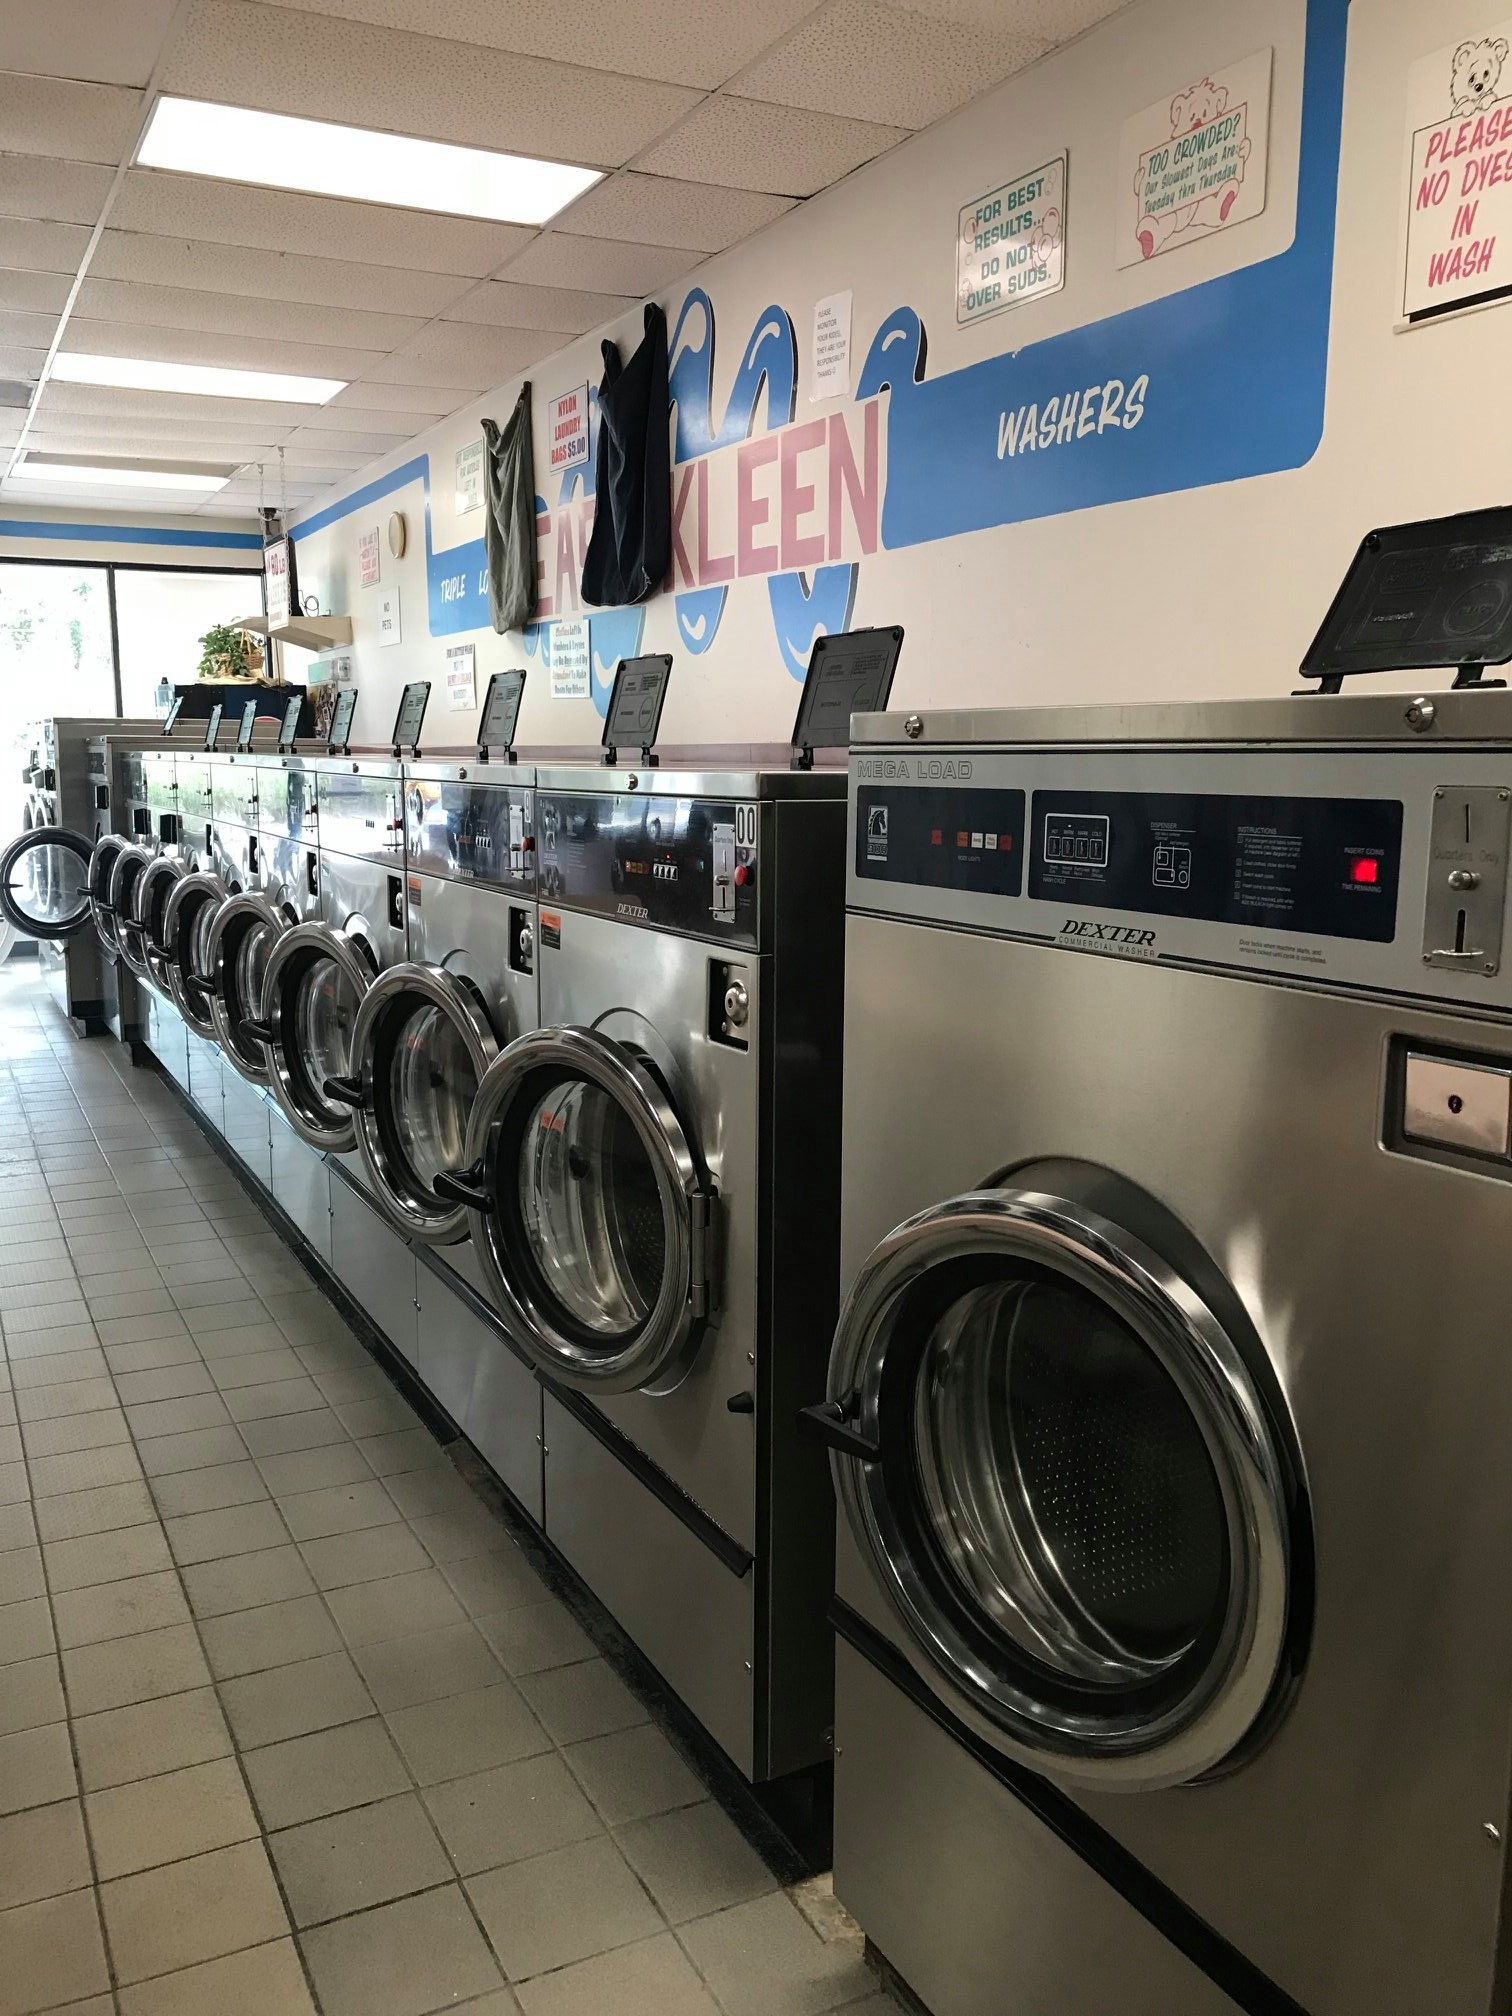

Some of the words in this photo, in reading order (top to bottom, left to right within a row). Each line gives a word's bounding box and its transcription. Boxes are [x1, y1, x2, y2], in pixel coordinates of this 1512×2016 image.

[1148, 149, 1169, 178] TOO
[1174, 112, 1241, 167] CROWDED?
[1425, 106, 1512, 168] PLEASE
[1145, 182, 1158, 197] Our
[1198, 153, 1218, 172] Days
[1222, 144, 1239, 162] Are:
[975, 200, 1001, 228] FOR
[1008, 178, 1044, 211] BEST
[1145, 192, 1175, 215] Tuesday
[1179, 183, 1196, 200] thru
[1200, 164, 1237, 191] Thursday
[1416, 169, 1450, 210] NO
[1451, 200, 1479, 240] IN
[981, 257, 999, 280] DO
[1006, 242, 1033, 269] NOT
[1428, 237, 1496, 288] WASH
[966, 281, 1001, 311] OVER
[1008, 263, 1051, 298] SUDS.
[817, 307, 831, 318] PLEASE
[817, 318, 837, 330] MONITOR
[817, 333, 828, 342] YOUR
[817, 346, 827, 354] THEY
[836, 340, 846, 349] YOUR
[558, 395, 577, 418] NYLON
[997, 374, 1149, 460] WASHERS
[555, 415, 581, 442] LAUNDRY
[551, 444, 567, 465] BAGS
[567, 437, 586, 459] $5.00
[663, 400, 879, 594] KLEEN
[441, 574, 466, 603] TRIPLE
[384, 602, 391, 613] NO
[382, 618, 392, 630] PETS
[858, 760, 911, 779] MEGA
[918, 760, 973, 780] LOAD
[1237, 826, 1277, 835] INSTRUCTIONS
[1365, 848, 1384, 856] COINS
[1479, 849, 1500, 867] Only
[1353, 884, 1382, 893] REMAINING
[617, 902, 649, 919] DEXTER
[1060, 919, 1156, 947] DEXTER
[1058, 935, 1113, 951] COMMERCIAL
[1118, 944, 1156, 959] WASHER
